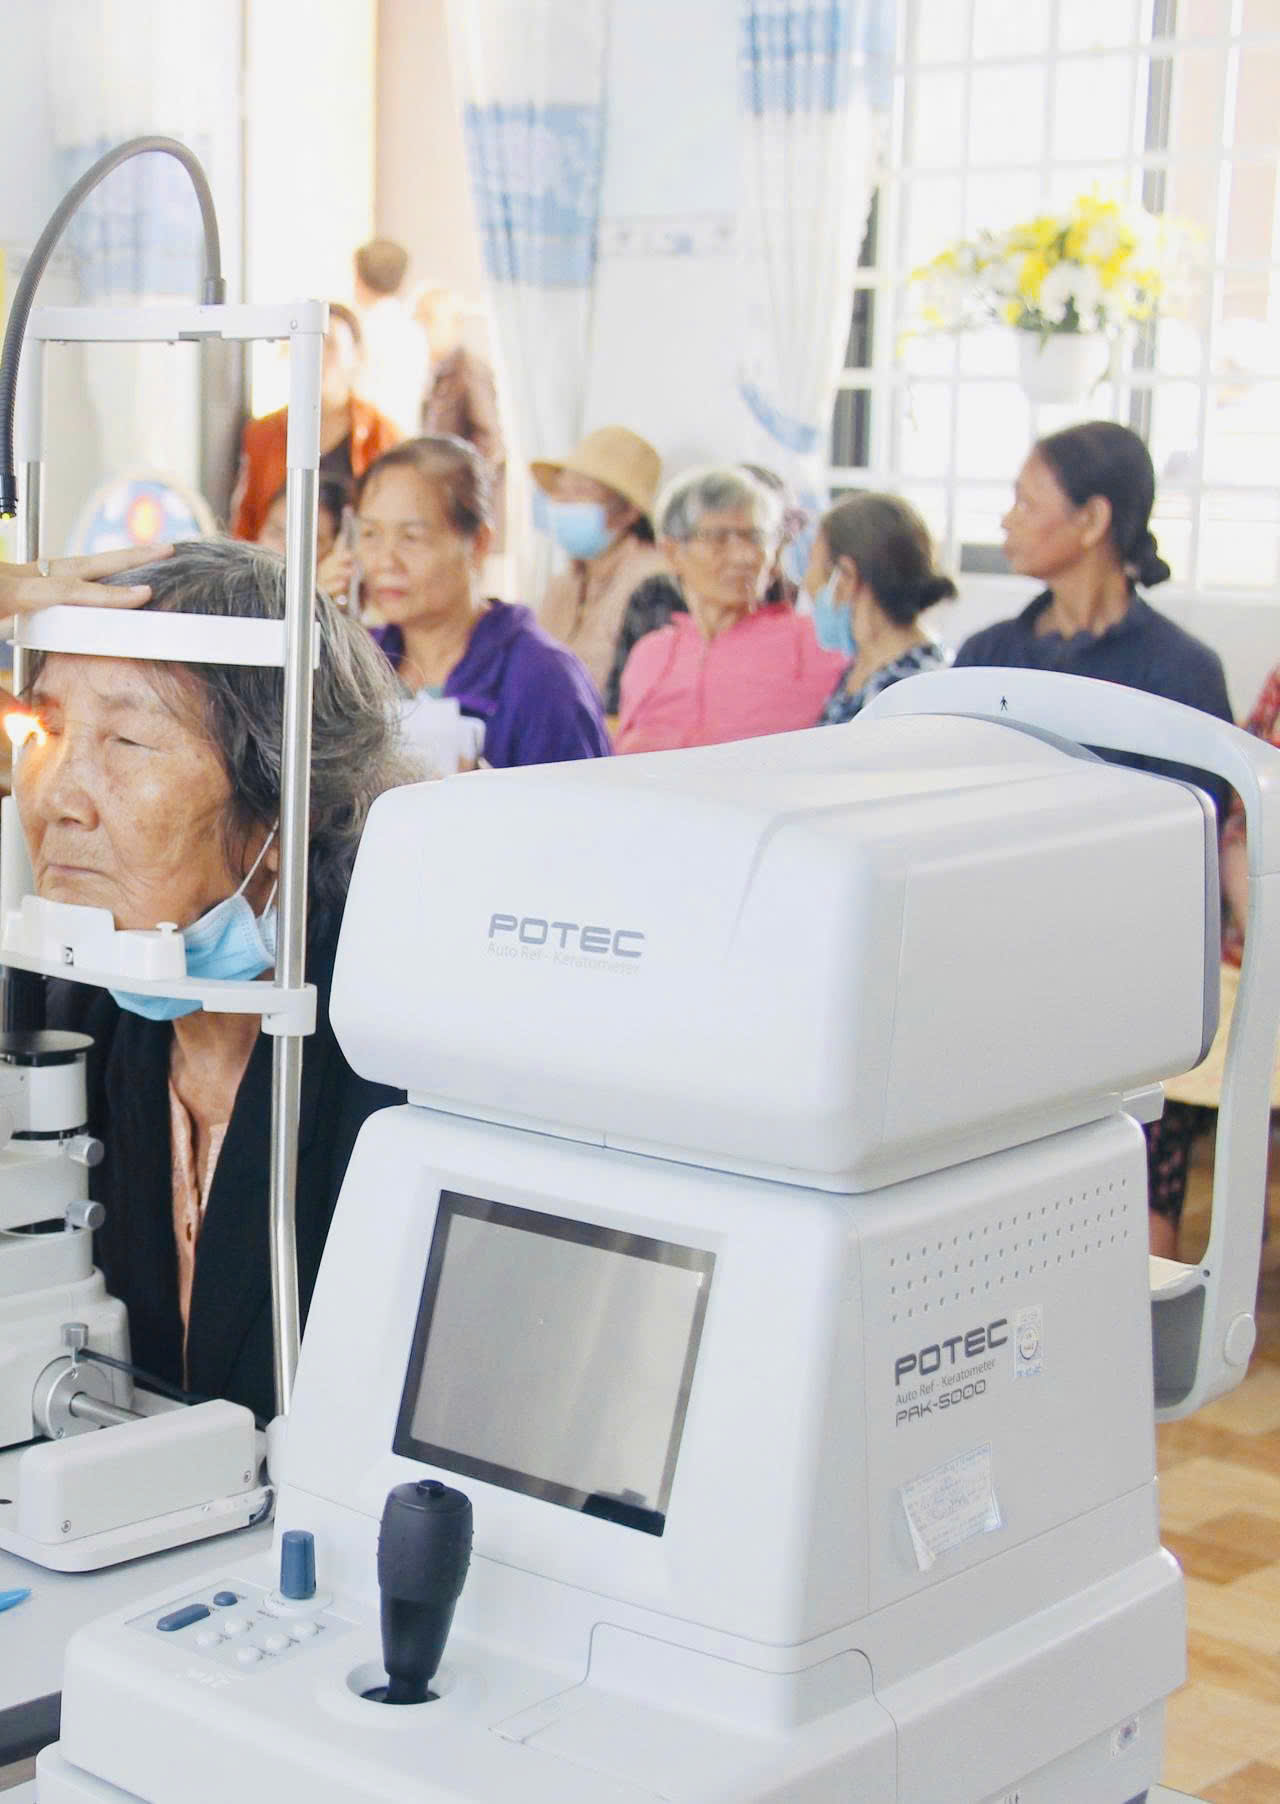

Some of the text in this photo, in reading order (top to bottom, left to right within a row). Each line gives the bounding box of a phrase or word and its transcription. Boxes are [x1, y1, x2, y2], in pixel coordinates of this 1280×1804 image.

[488, 913, 646, 958] POTEC
[895, 1318, 1008, 1386] POTEC
[896, 1389, 917, 1406] Auto
[920, 1381, 934, 1396] Ref
[942, 1358, 997, 1388] Keratometer
[896, 1379, 986, 1427] PAK-5000
